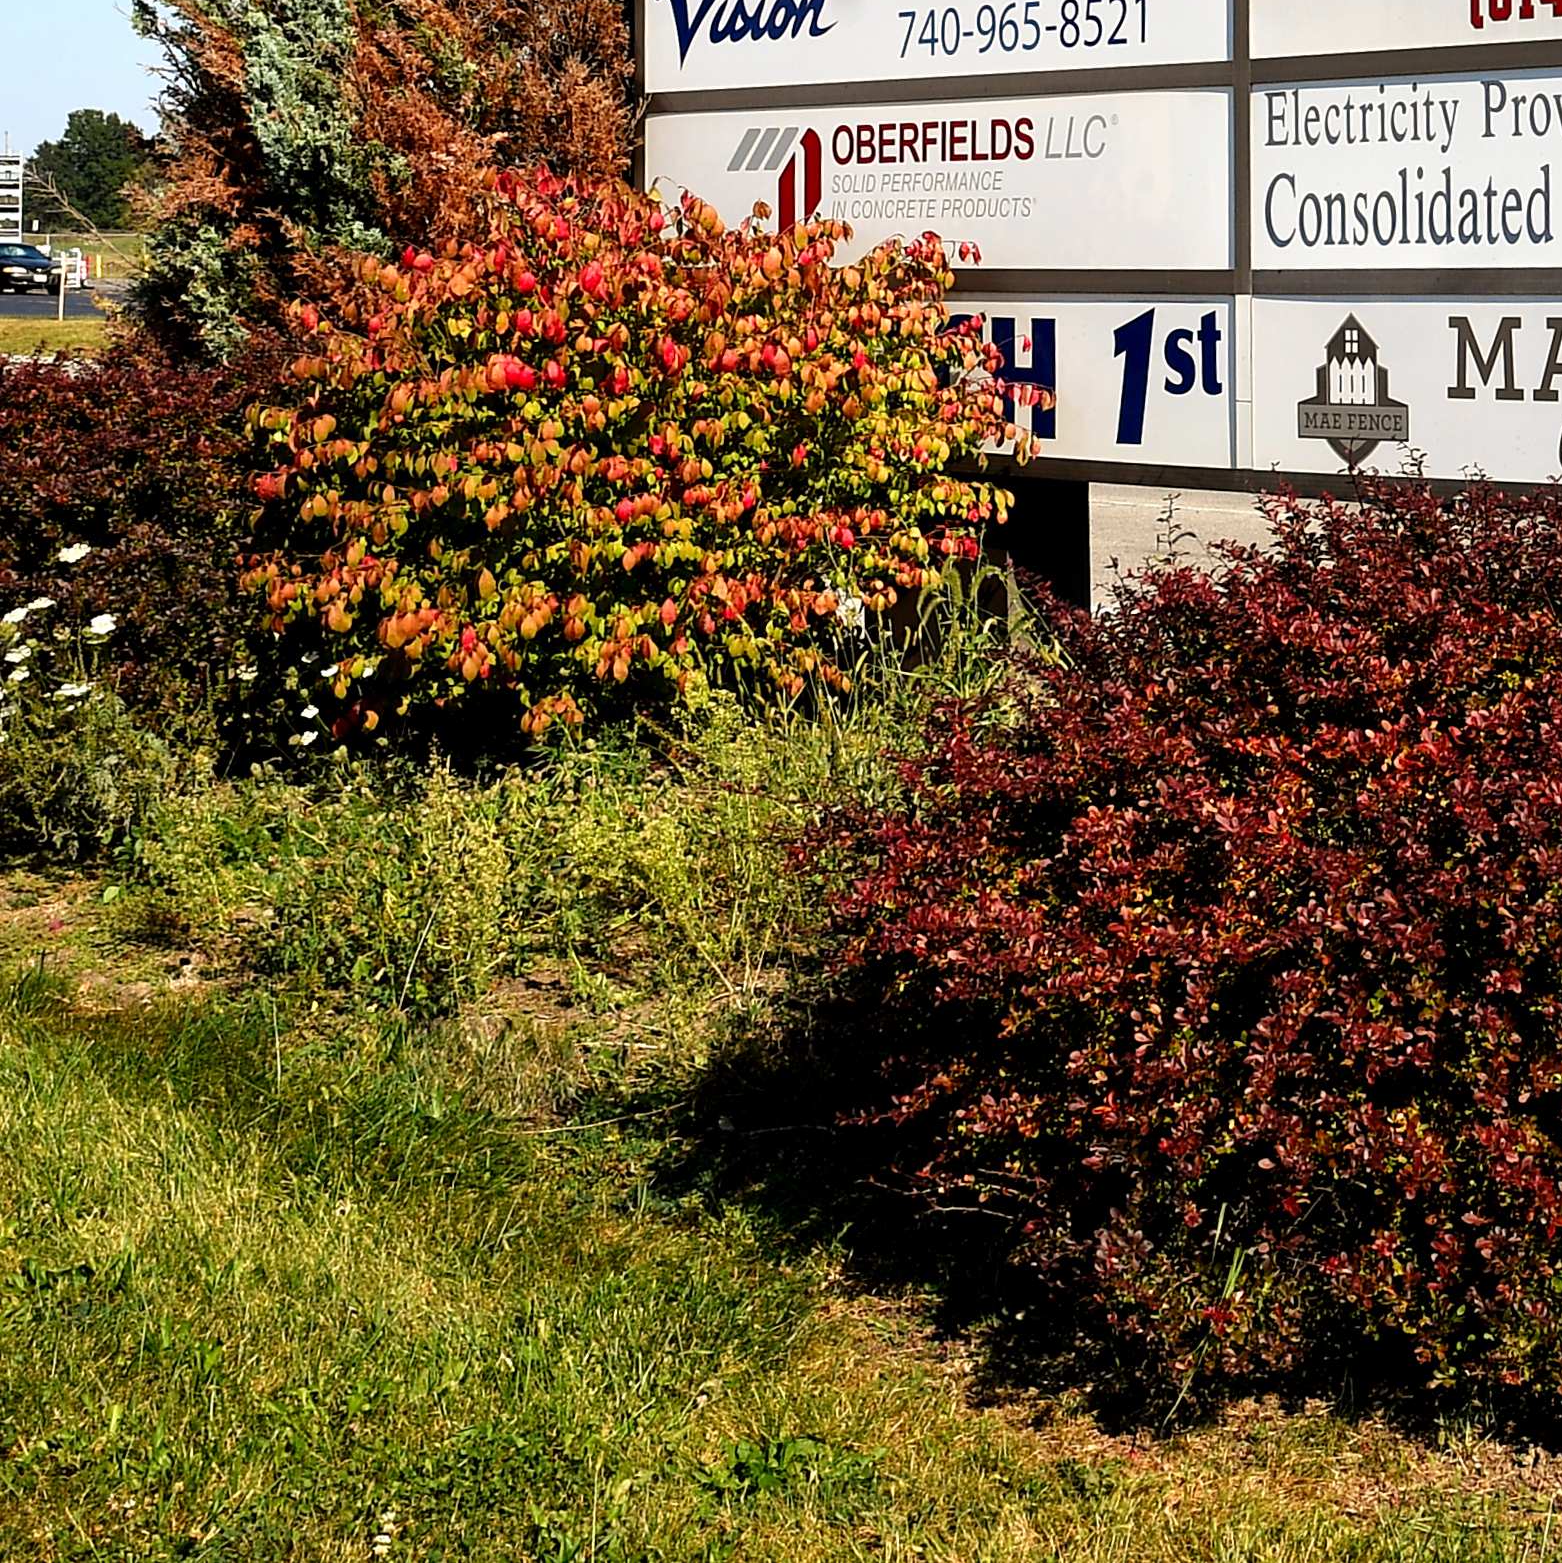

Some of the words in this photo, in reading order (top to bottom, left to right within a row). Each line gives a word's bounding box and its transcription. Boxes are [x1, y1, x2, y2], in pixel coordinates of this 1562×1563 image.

[832, 118, 1034, 165] OBERFIELDS
[1264, 84, 1459, 152] Electricity
[832, 173, 876, 193] SOLID
[880, 171, 1003, 192] PERFORMANCE
[831, 201, 846, 219] IN
[851, 198, 936, 219] CONCRETE
[1264, 165, 1553, 248] Consolidated
[1113, 307, 1223, 444] 1st
[1304, 412, 1341, 429] MAE
[1347, 413, 1403, 431] FENCE
